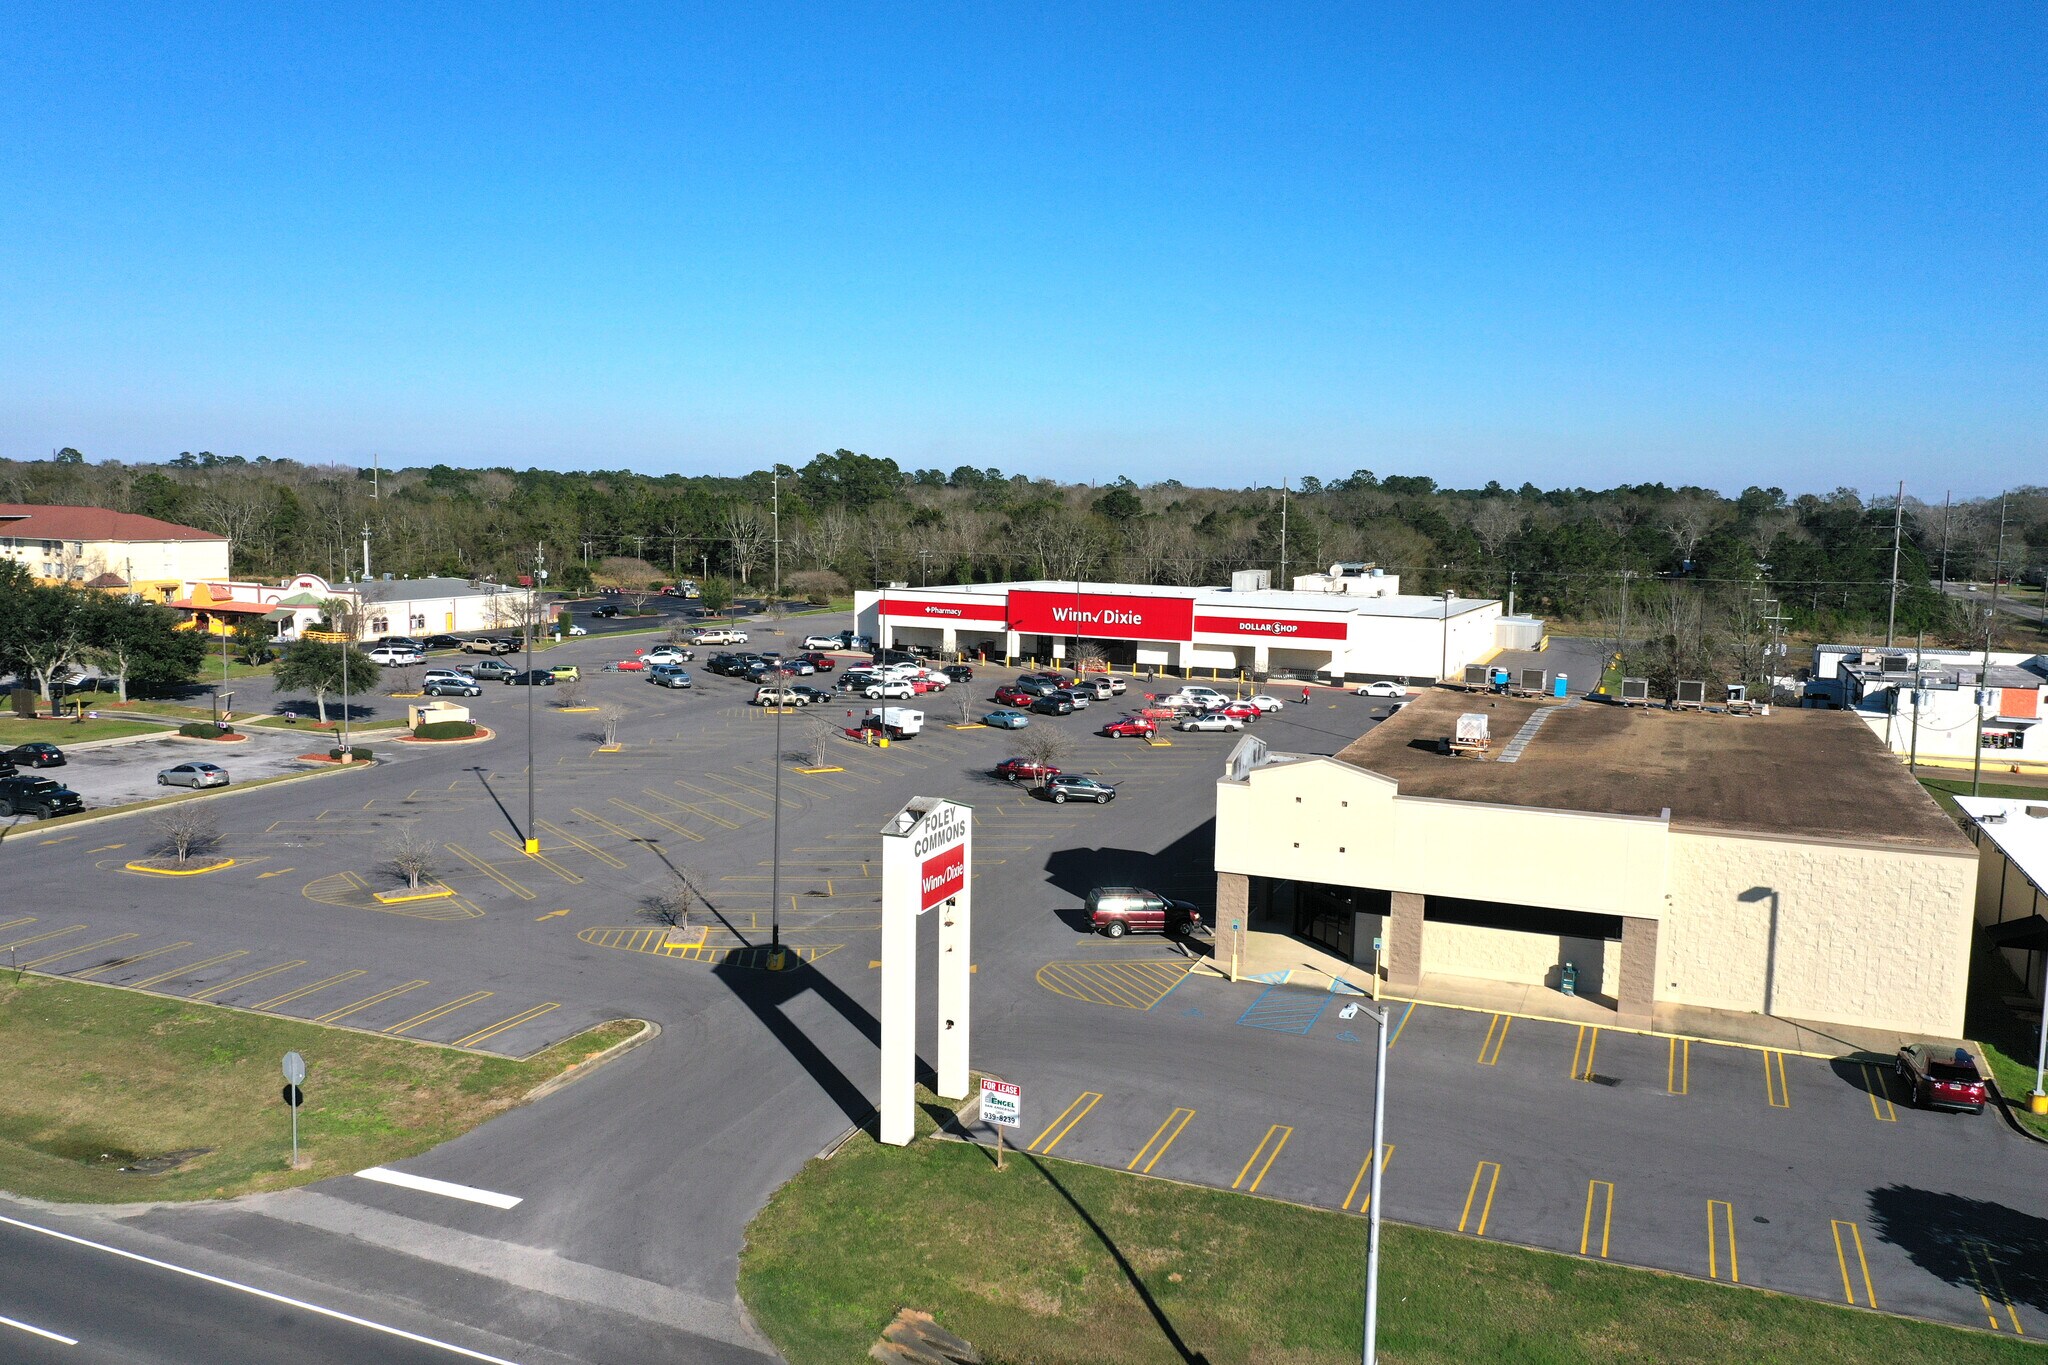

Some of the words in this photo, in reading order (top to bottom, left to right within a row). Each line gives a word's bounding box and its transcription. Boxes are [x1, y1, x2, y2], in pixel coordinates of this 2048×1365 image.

[930, 606, 962, 617] Pharmacy
[1239, 623, 1272, 632] DOLLAR
[925, 806, 956, 834] FOLEY
[914, 819, 966, 858] COMMONS
[983, 1081, 996, 1091] FOR
[998, 1083, 1018, 1095] LEASE
[991, 1097, 1015, 1108] ENGEL
[984, 1112, 1016, 1124] 939-8239
